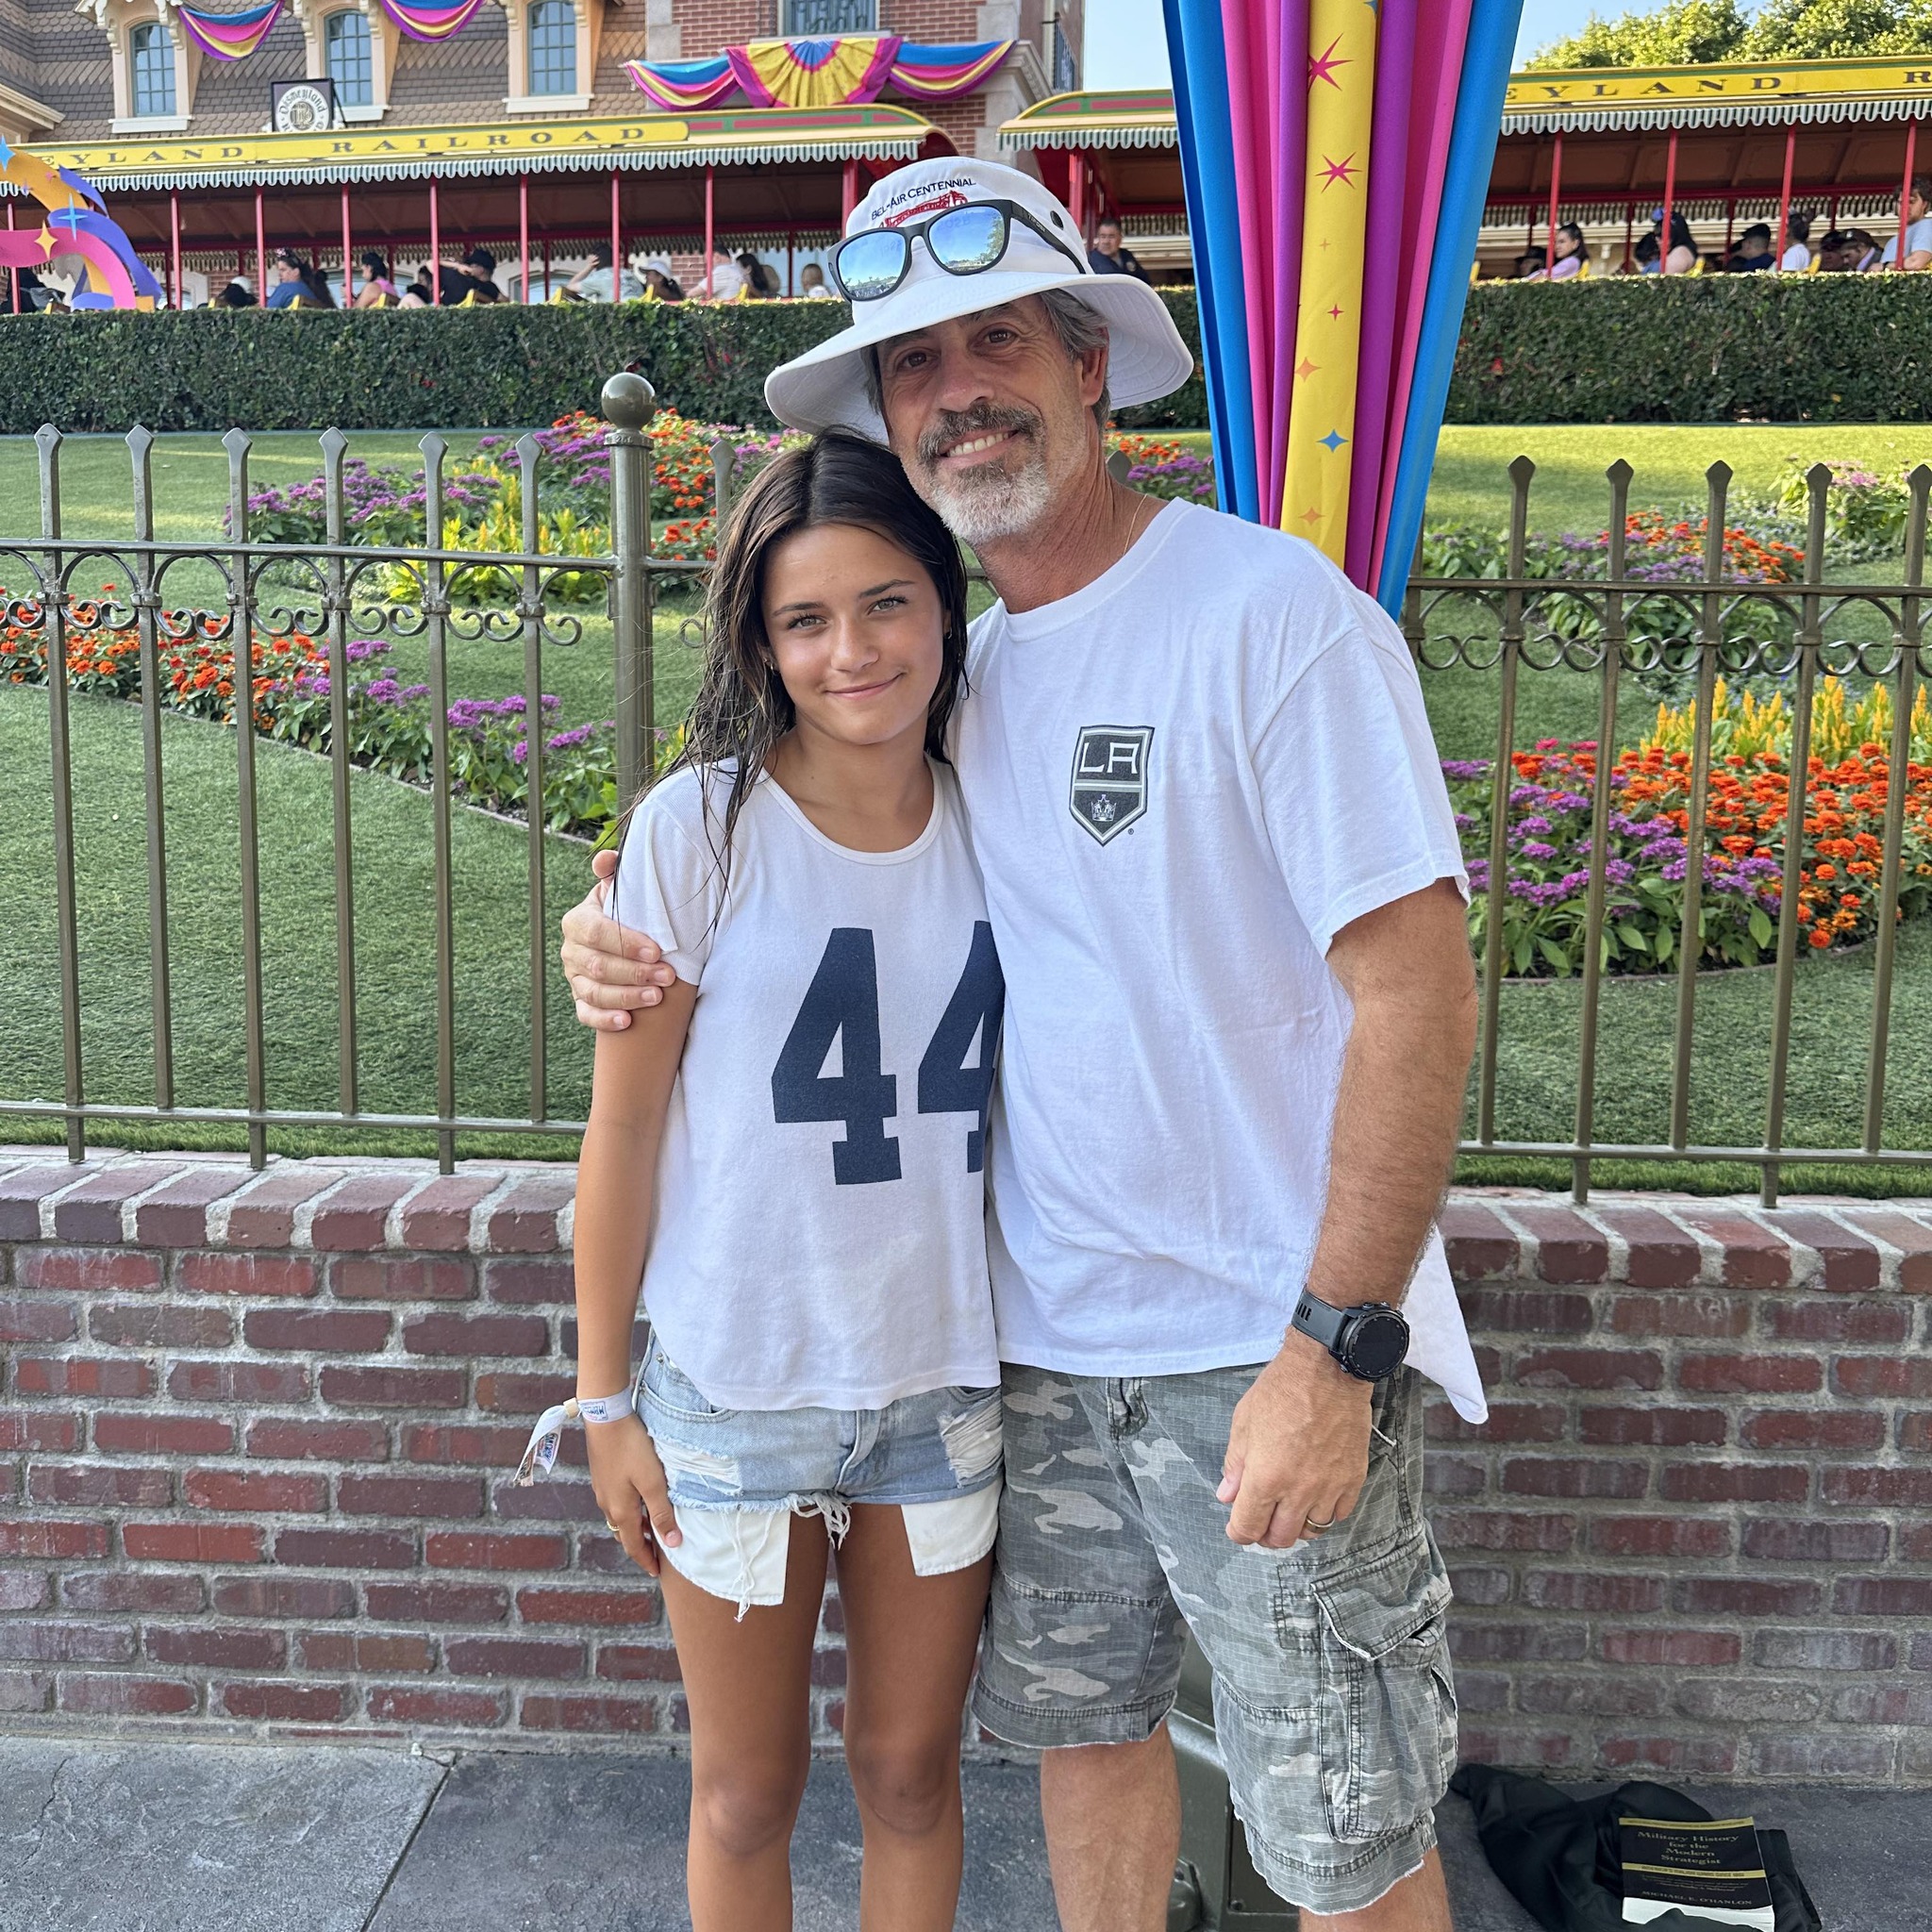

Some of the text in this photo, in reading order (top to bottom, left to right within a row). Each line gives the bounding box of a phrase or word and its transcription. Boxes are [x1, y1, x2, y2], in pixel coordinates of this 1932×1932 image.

[332, 127, 645, 154] RAILROAD
[871, 177, 976, 221] BEL-AIR CENTENNIAL
[1079, 741, 1140, 774] LA
[771, 920, 1006, 1186] 44
[1637, 1831, 1689, 1842] Military
[1660, 1854, 1721, 1865] Strategist
[1665, 1847, 1715, 1857] Modern
[1641, 1890, 1687, 1901] MICHAEL
